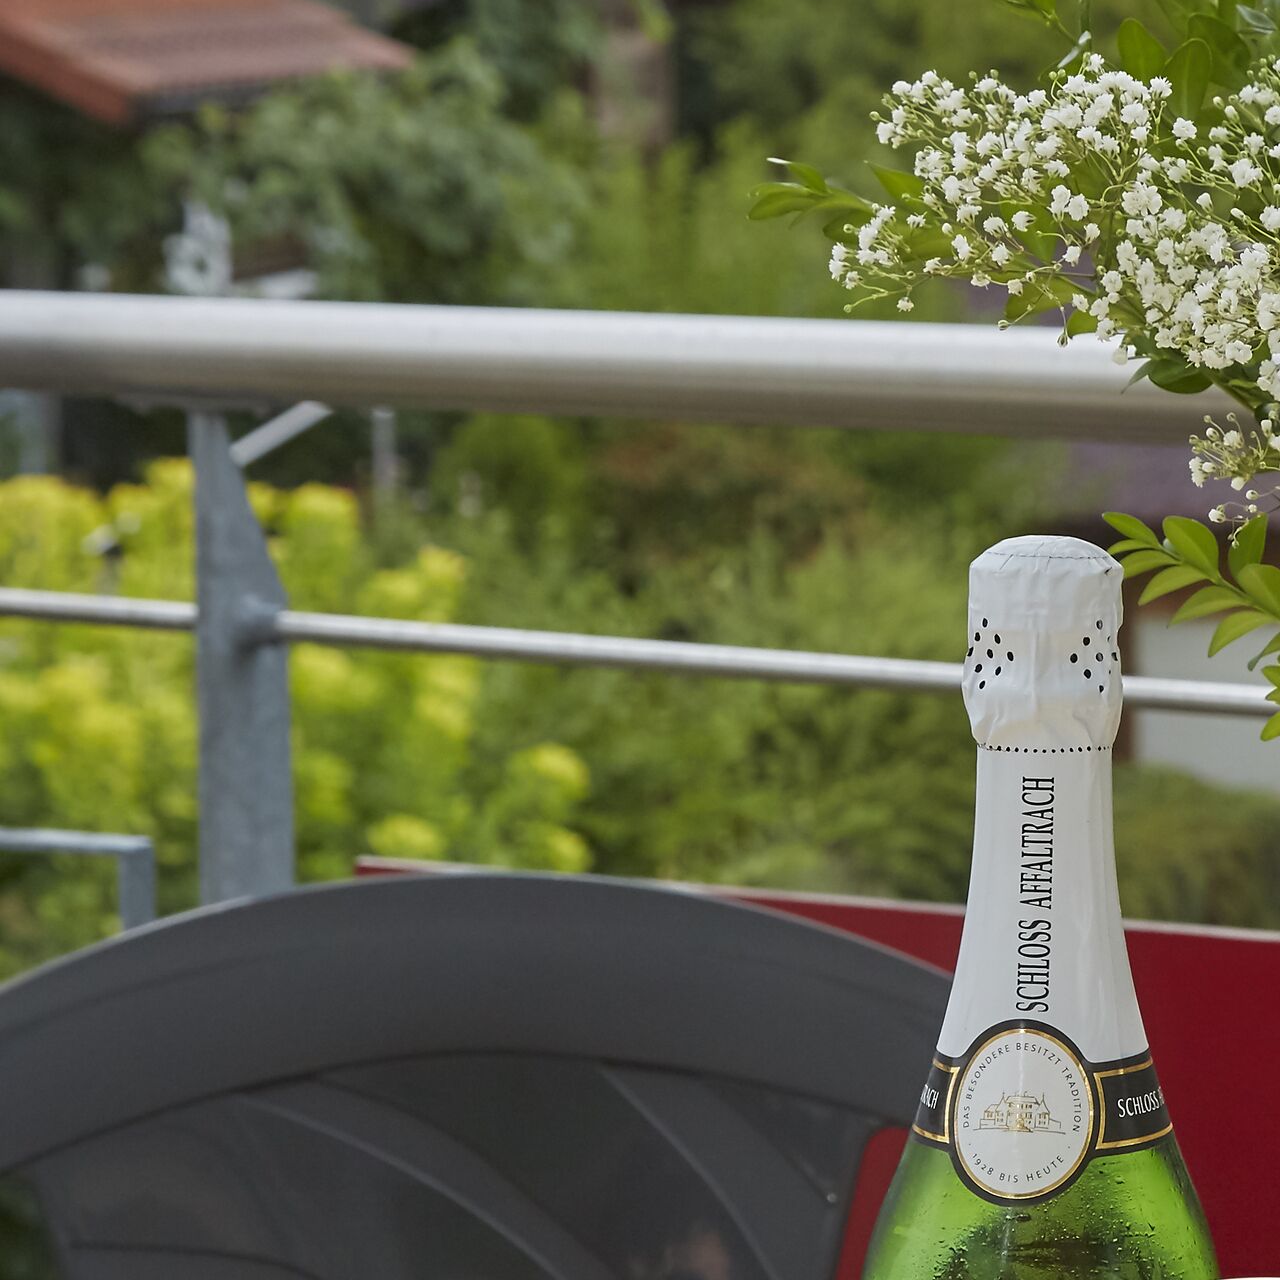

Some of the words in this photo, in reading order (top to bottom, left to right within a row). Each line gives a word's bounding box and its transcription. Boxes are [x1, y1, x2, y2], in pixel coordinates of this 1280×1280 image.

[1020, 776, 1055, 910] AFFALTRACH
[1016, 919, 1051, 1013] SCHLOSS
[966, 1044, 1010, 1100] BESONDERE
[1016, 1042, 1062, 1065] BESITZT
[1061, 1067, 1082, 1133] TRADITION
[1117, 1090, 1160, 1118] SCHLOSS
[972, 1153, 994, 1176] 1928
[999, 1172, 1018, 1184] BIS
[1026, 1155, 1065, 1182] HEUTE
